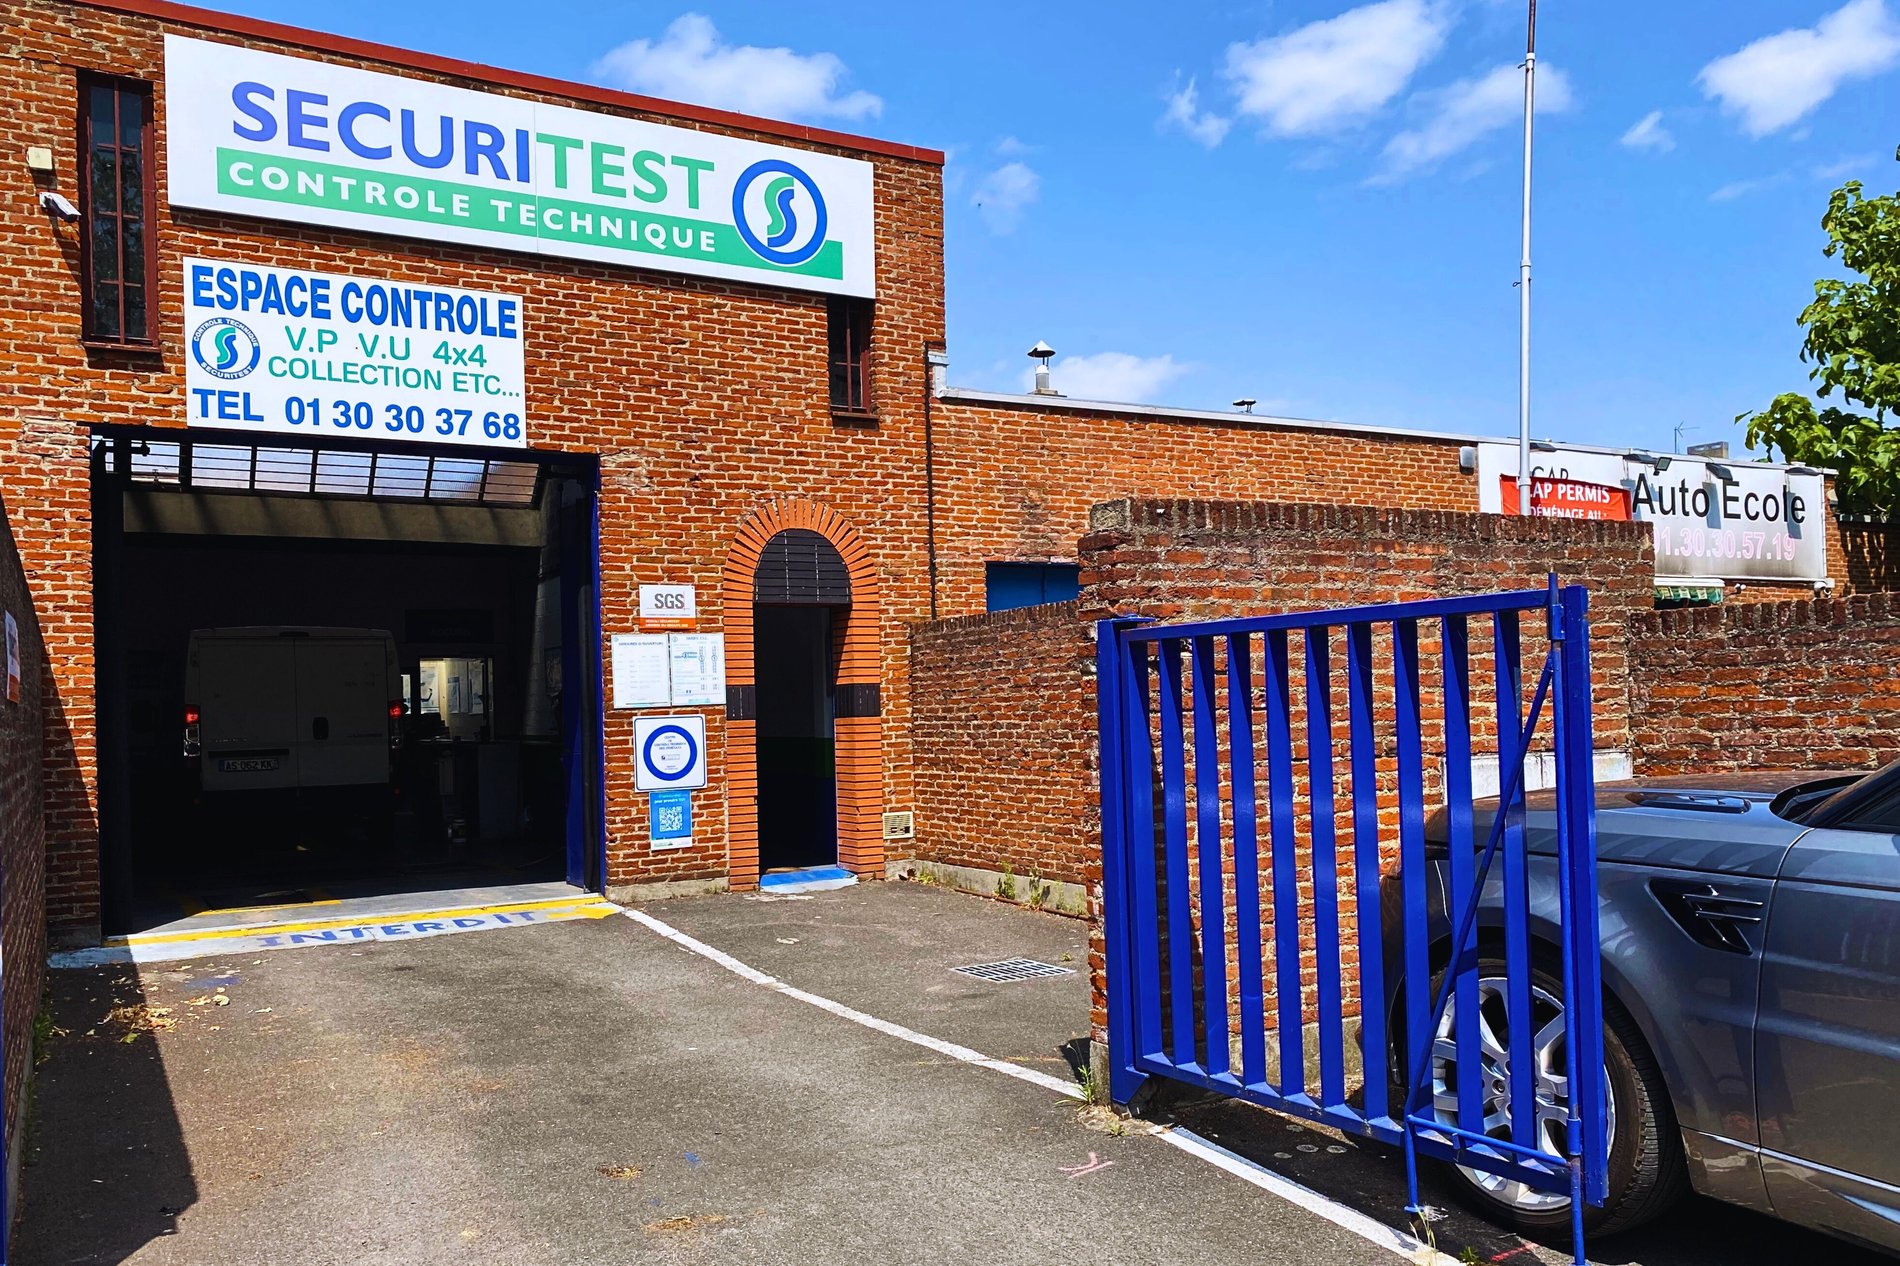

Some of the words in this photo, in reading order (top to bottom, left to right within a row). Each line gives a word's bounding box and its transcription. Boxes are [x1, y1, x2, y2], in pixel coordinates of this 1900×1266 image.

[230, 81, 715, 211] SECURITEST
[228, 161, 472, 219] CONTROLE
[490, 199, 717, 254] TECHNIQUE
[192, 264, 332, 320] ESPACE
[340, 281, 517, 340] CONTROLE
[194, 319, 223, 342] CONTROLE
[226, 319, 259, 348] TECHNIQUE
[284, 325, 339, 354] V.P
[358, 332, 411, 361] V.U
[432, 340, 488, 368] 4x4
[201, 361, 253, 379] SECURITEST
[267, 355, 442, 391] COLLECTION
[452, 371, 521, 398] ETC...
[192, 388, 265, 423] TEL
[284, 396, 320, 426] 01
[332, 400, 374, 430] 30
[384, 404, 425, 433] 30
[435, 408, 473, 436] 37
[483, 411, 521, 441] 68
[1558, 483, 1611, 504] PERMIS
[1631, 473, 1710, 518] Auto
[1723, 480, 1806, 524] Ecole
[654, 593, 685, 609] SGS
[256, 911, 534, 947] INTERDIT
